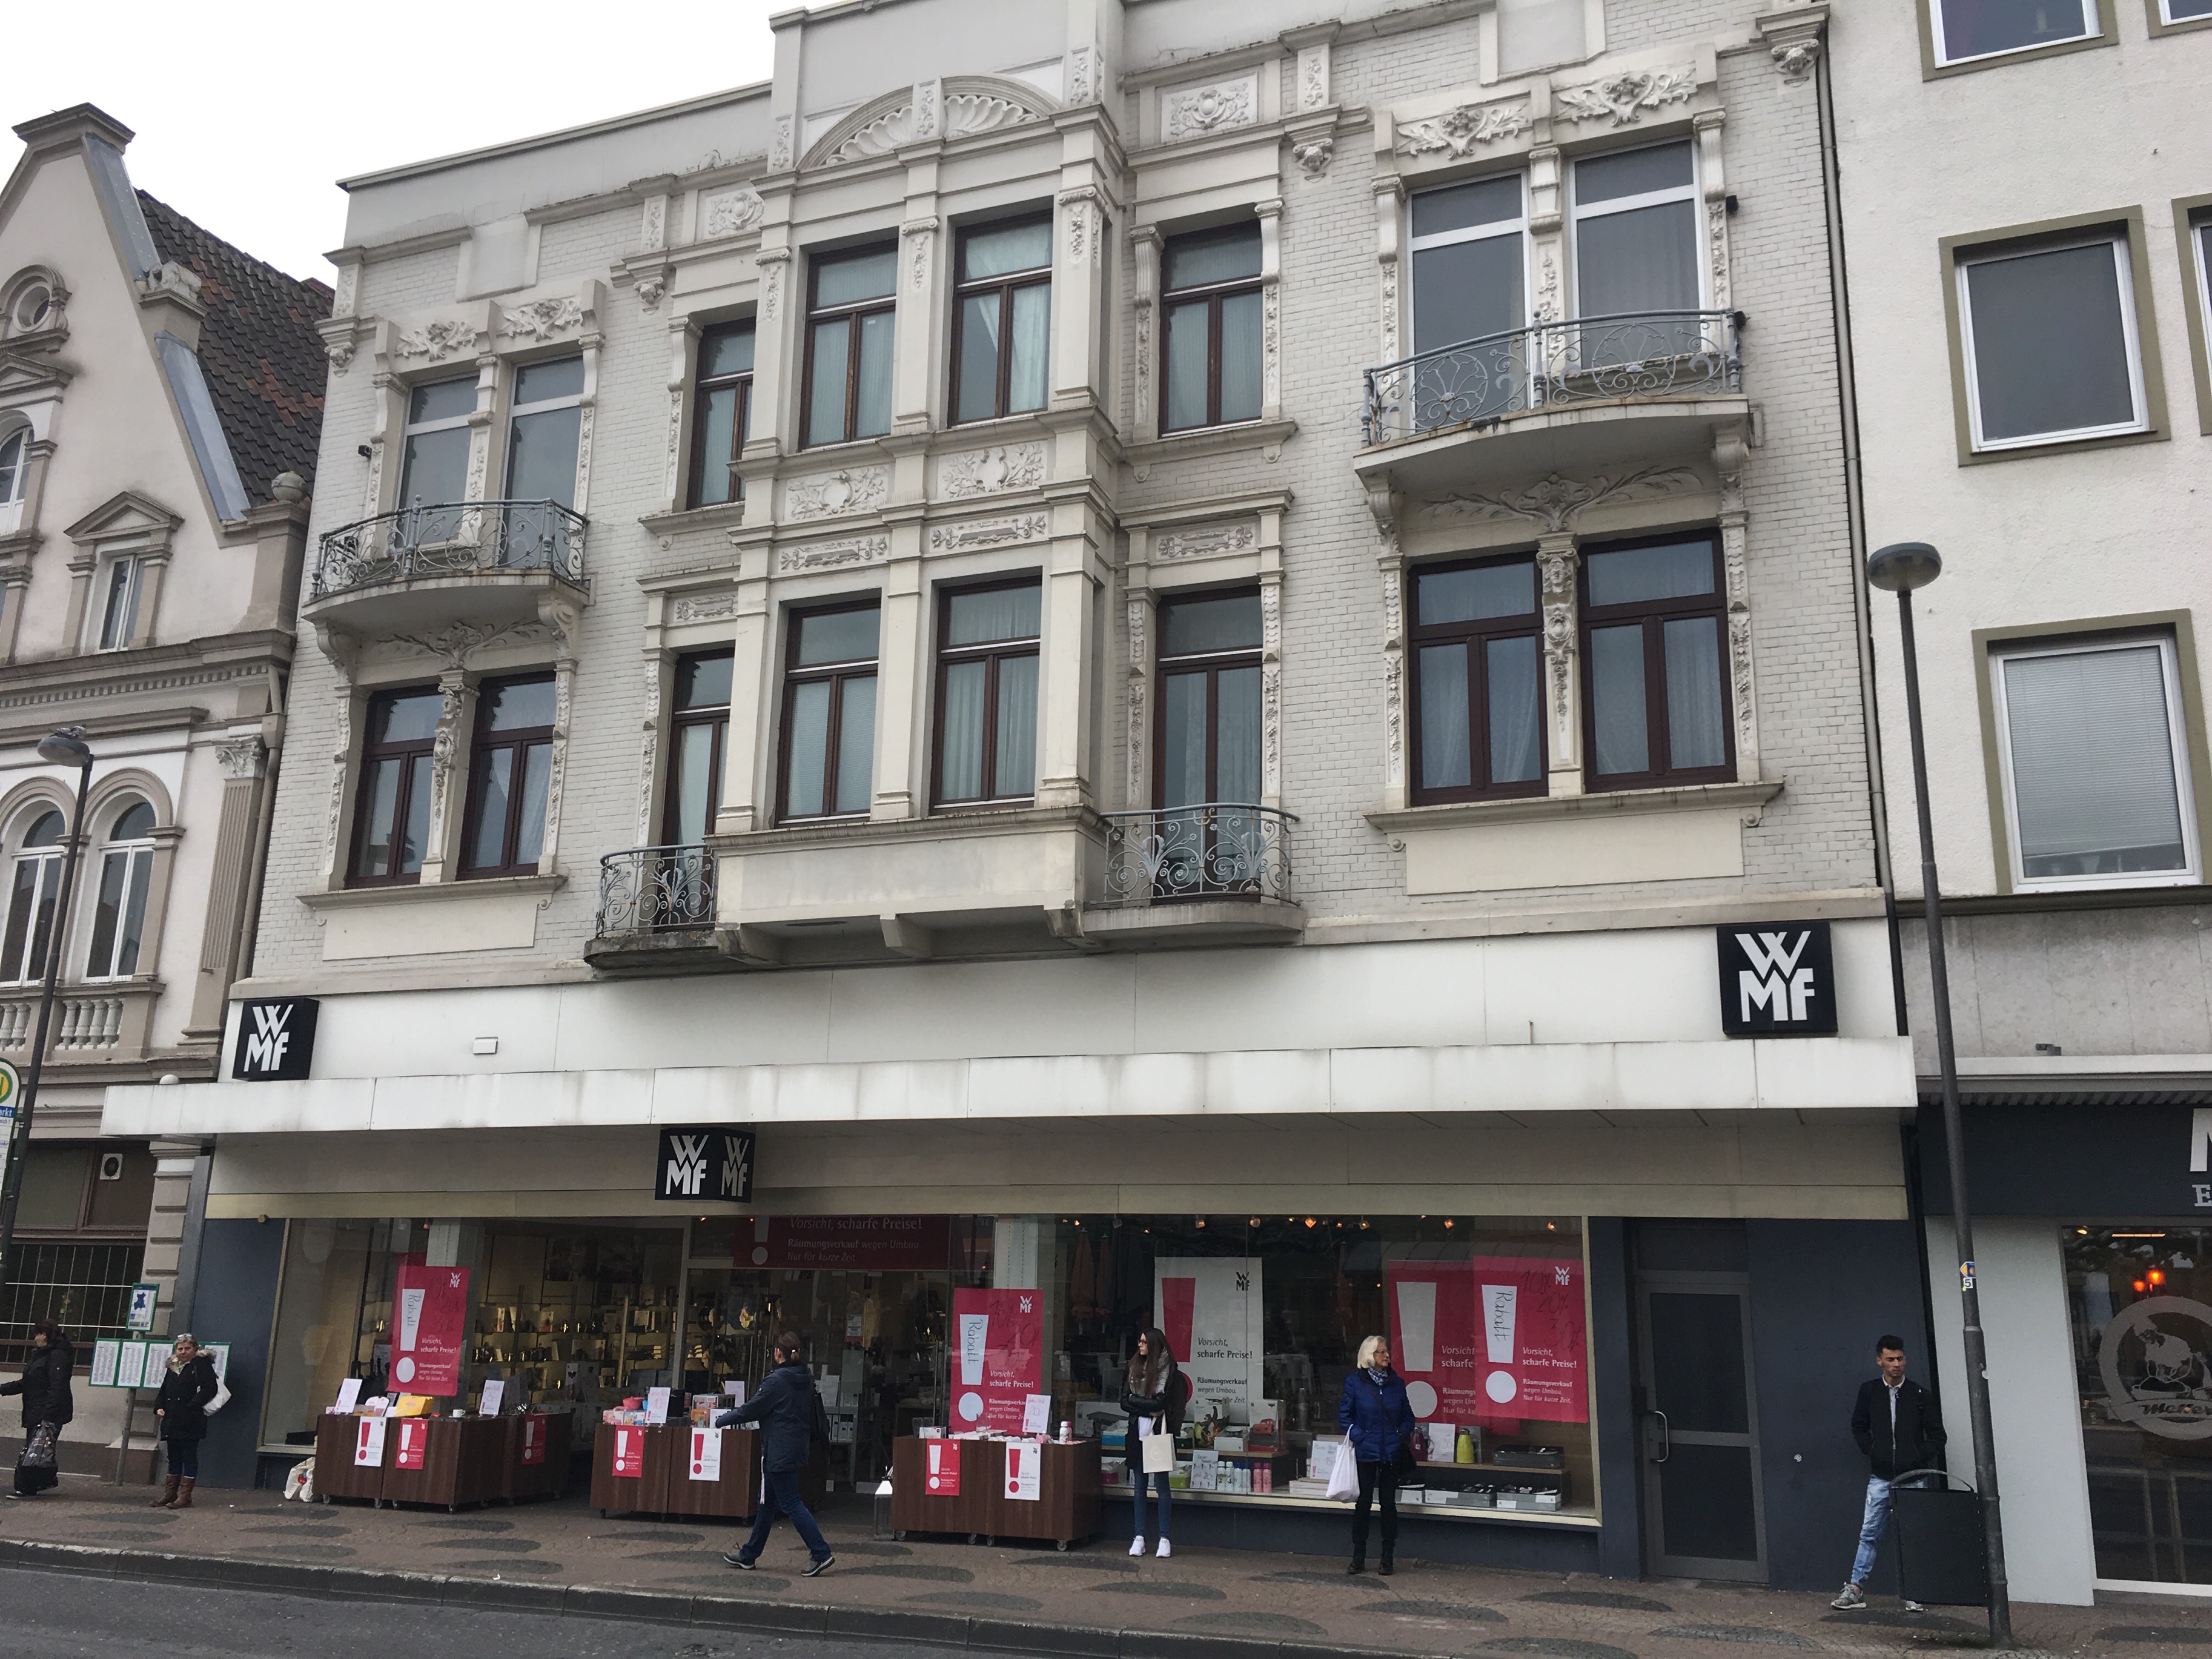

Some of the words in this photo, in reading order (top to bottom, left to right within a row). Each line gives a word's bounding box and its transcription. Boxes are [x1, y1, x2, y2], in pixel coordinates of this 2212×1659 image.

[1735, 930, 1815, 1022] WMF
[243, 1004, 294, 1071] WMF
[666, 1134, 709, 1194] WMF
[721, 1136, 749, 1197] WMF
[789, 1216, 834, 1230] Vorsicht,
[837, 1217, 878, 1230] scharfe
[882, 1217, 922, 1230] Preise!
[787, 1239, 859, 1250] Räumungsverkauf
[861, 1242, 887, 1251] wegen
[804, 1252, 815, 1260] für
[818, 1252, 839, 1261] kurze
[1965, 1279, 1972, 1288] 5
[1198, 1337, 1228, 1346] Vorsicht,
[1227, 1350, 1253, 1359] Preise!
[1523, 1347, 1553, 1356] Vorsicht,
[1442, 1359, 1473, 1368] scharfe
[1522, 1358, 1550, 1366] scharfe
[1552, 1359, 1577, 1368] Preise!
[1523, 1379, 1572, 1388] Räumungsverkauf
[1443, 1388, 1475, 1397] Räumungs
